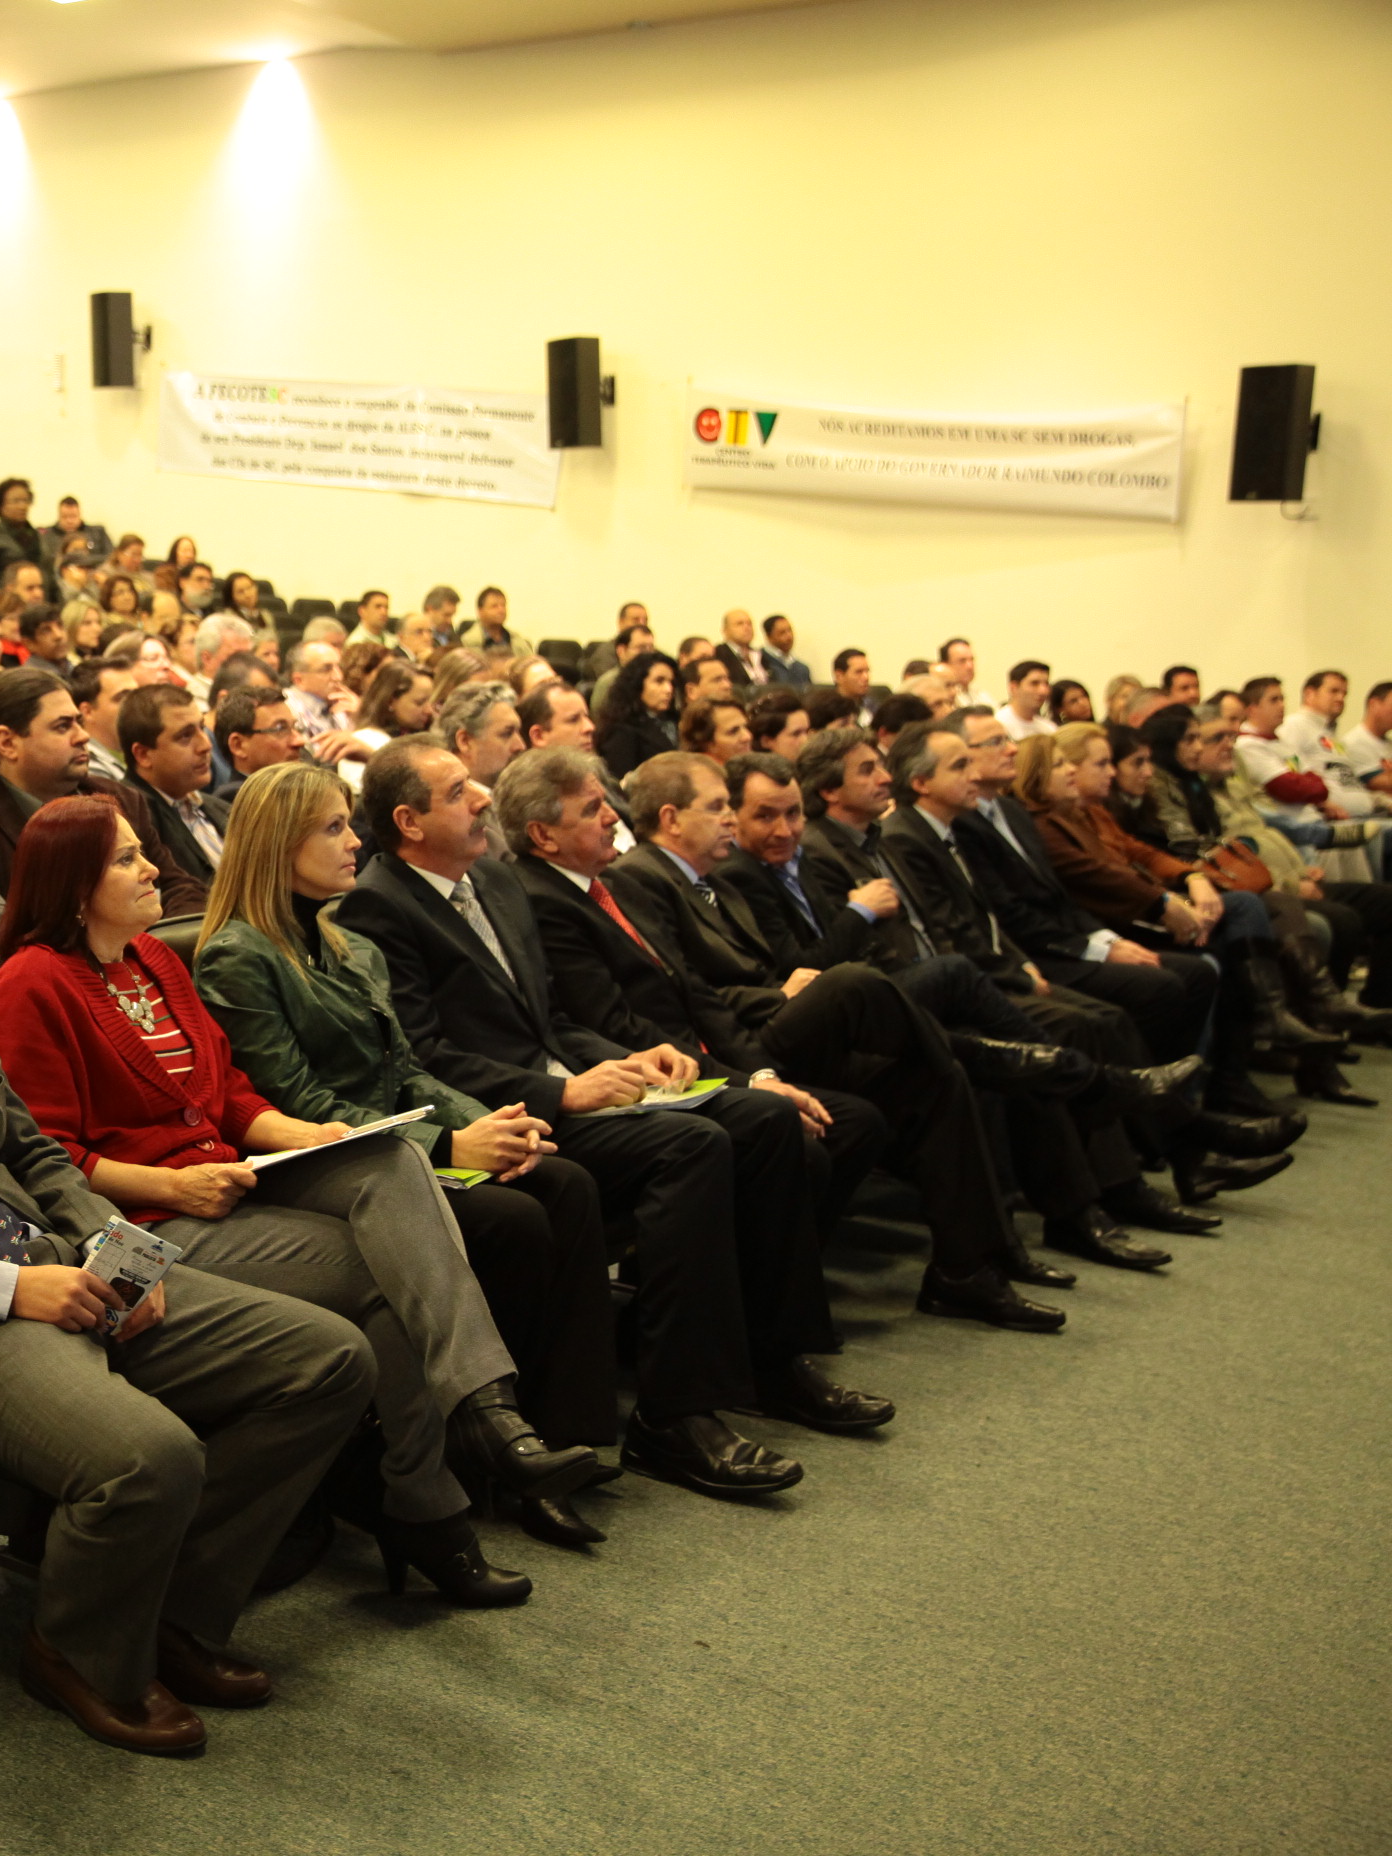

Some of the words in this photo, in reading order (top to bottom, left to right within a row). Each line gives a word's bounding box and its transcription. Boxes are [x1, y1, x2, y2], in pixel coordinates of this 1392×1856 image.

[818, 416, 844, 434] NÓS
[848, 419, 944, 441] ACREDITAMOS
[948, 424, 970, 442] EM
[974, 427, 1008, 444] UMA
[1011, 431, 1029, 445] SC
[1032, 430, 1064, 446] SEM
[834, 456, 874, 473] APOIO
[876, 458, 896, 474] DO
[898, 459, 998, 480] GOVERNADOR
[1001, 465, 1084, 485] RAIMUNDO
[1086, 470, 1171, 490] COLOMBO
